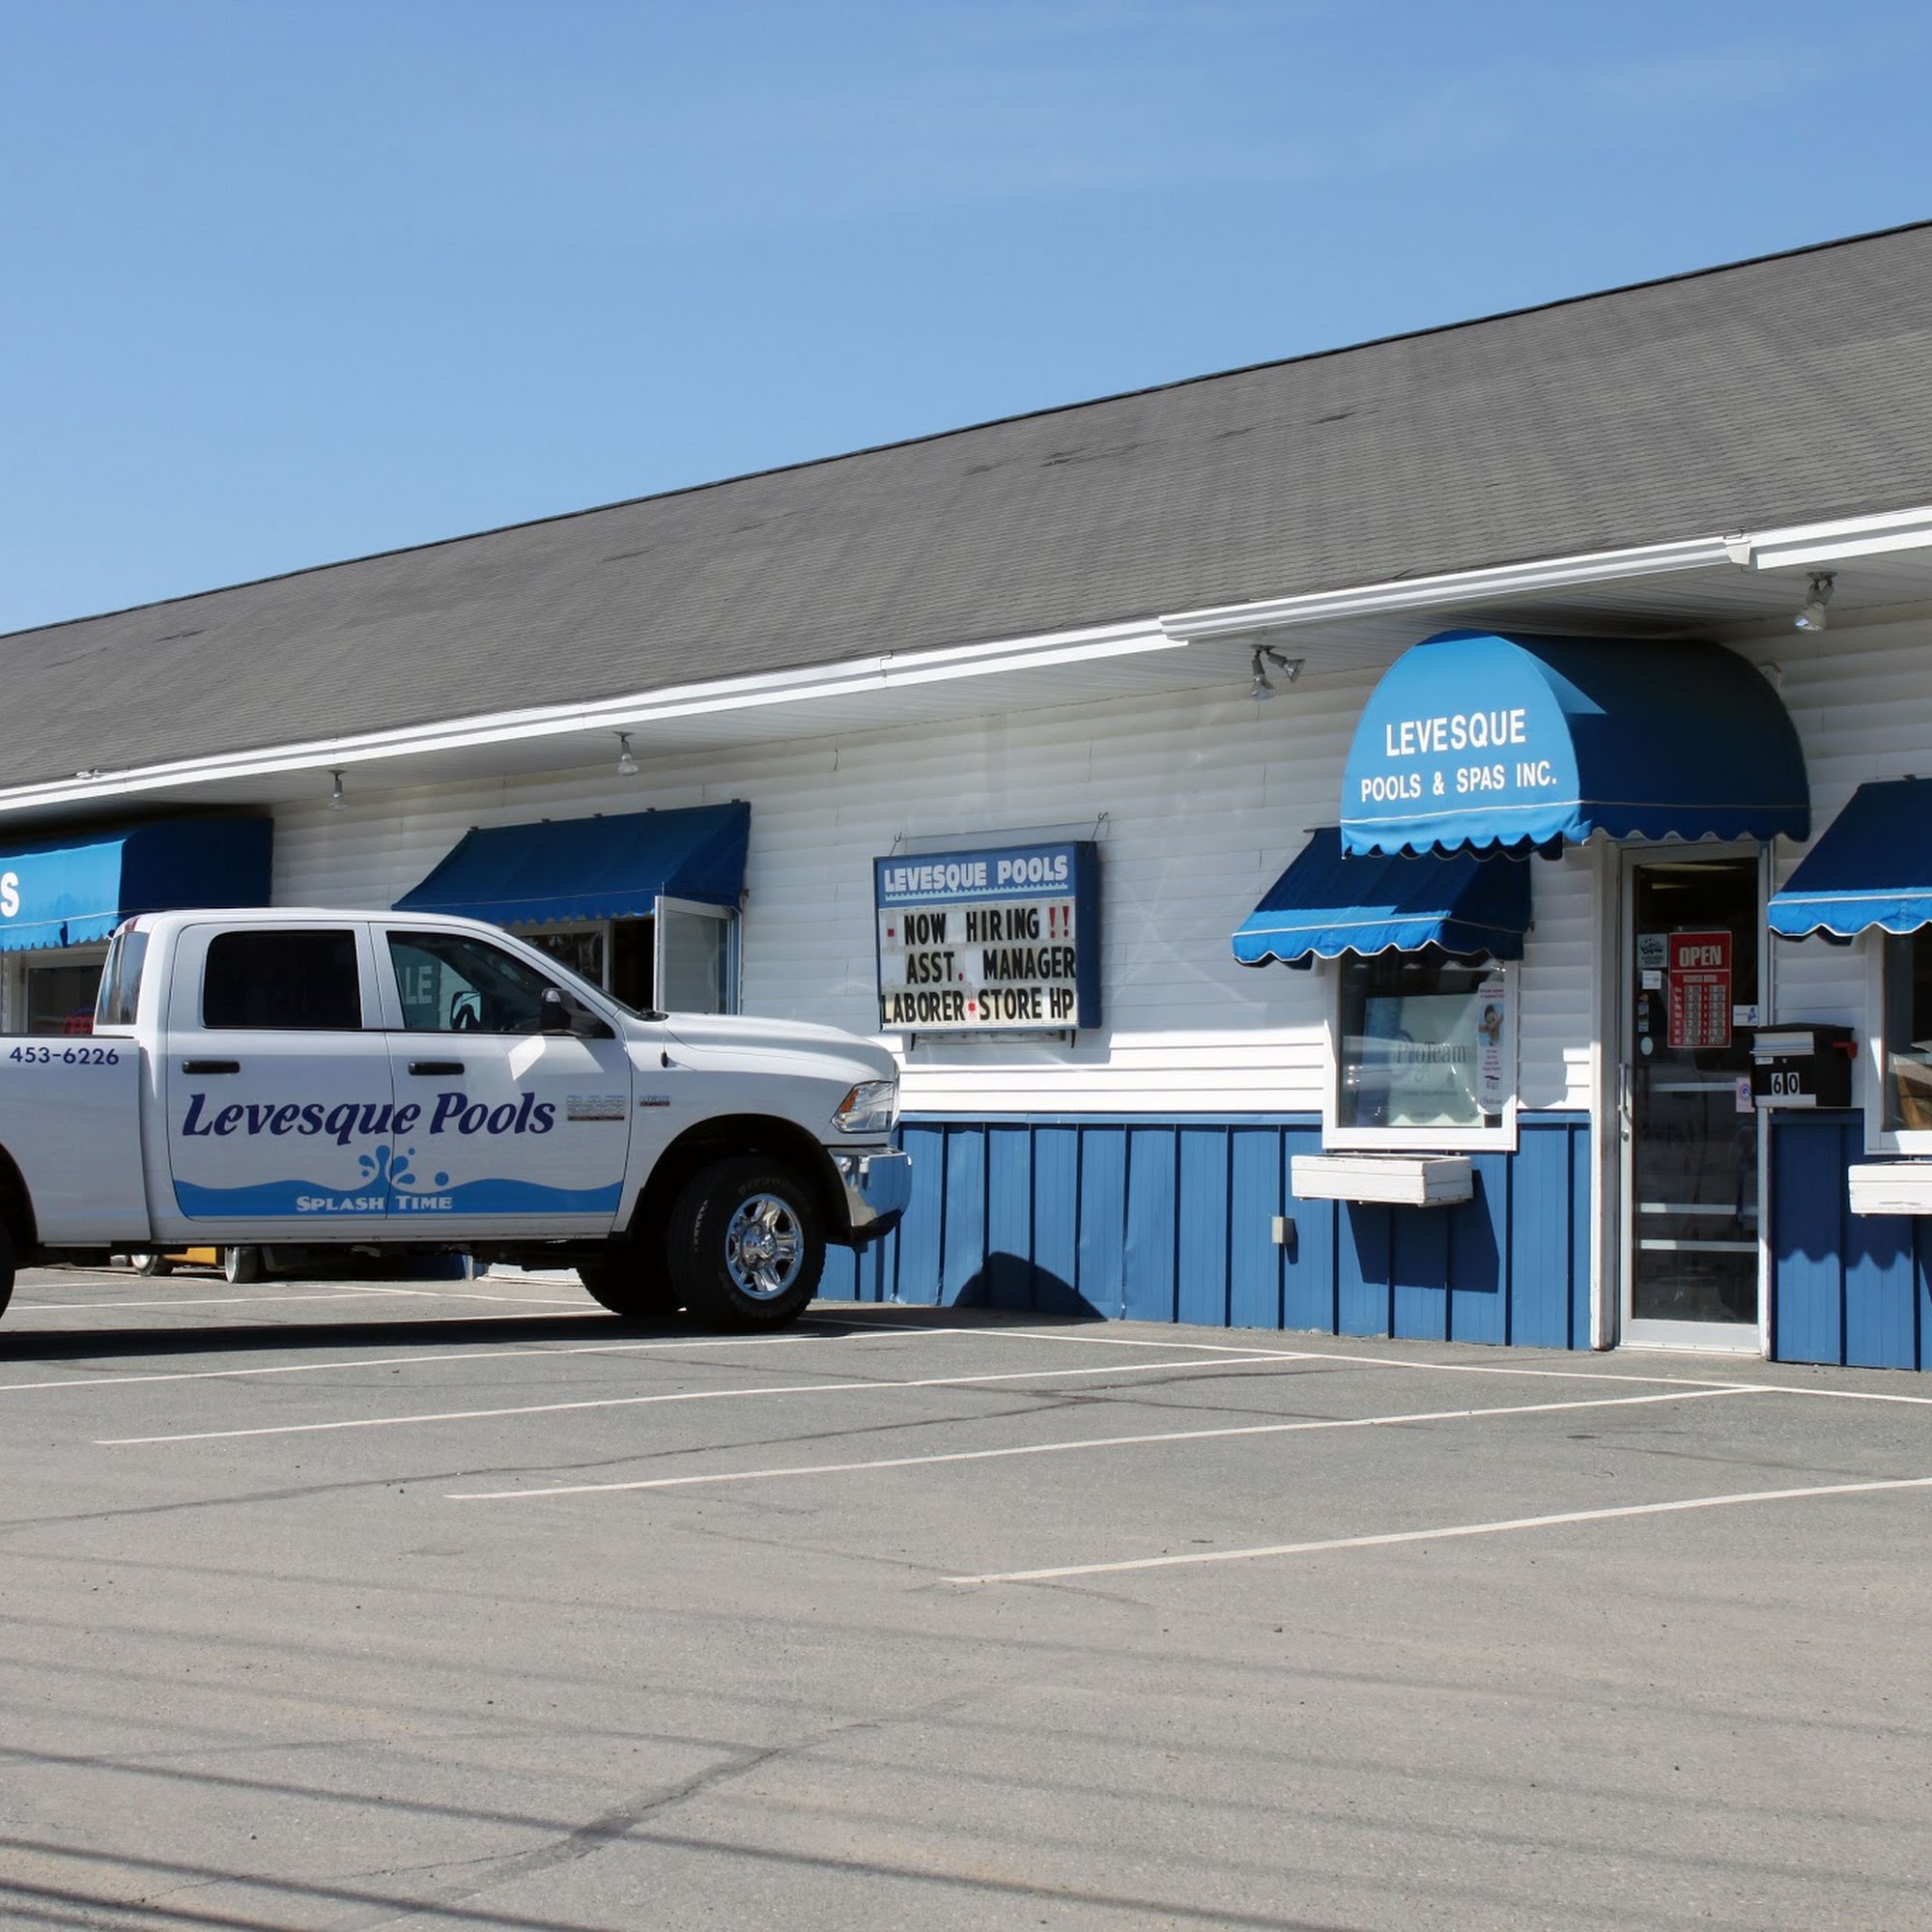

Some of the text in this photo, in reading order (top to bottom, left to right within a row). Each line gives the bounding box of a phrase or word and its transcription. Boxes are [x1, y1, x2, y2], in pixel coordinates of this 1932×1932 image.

[1385, 708, 1527, 757] LEVESQUE
[1360, 760, 1557, 803] POOLS & SPAS INC.
[884, 855, 1068, 893] LEVESQUE POOLS
[904, 913, 947, 945] NOW
[966, 908, 1039, 943] HIRING
[907, 946, 1076, 984] ASST. MANAGER
[1679, 946, 1721, 967] OPEN
[882, 986, 1074, 1024] LABORER STORE HP
[9, 1047, 119, 1065] 453-6226
[1773, 1073, 1799, 1094] 60
[182, 1094, 421, 1146] Levesque
[430, 1092, 556, 1135] Pools
[296, 1195, 453, 1211] SPLASH TIME
